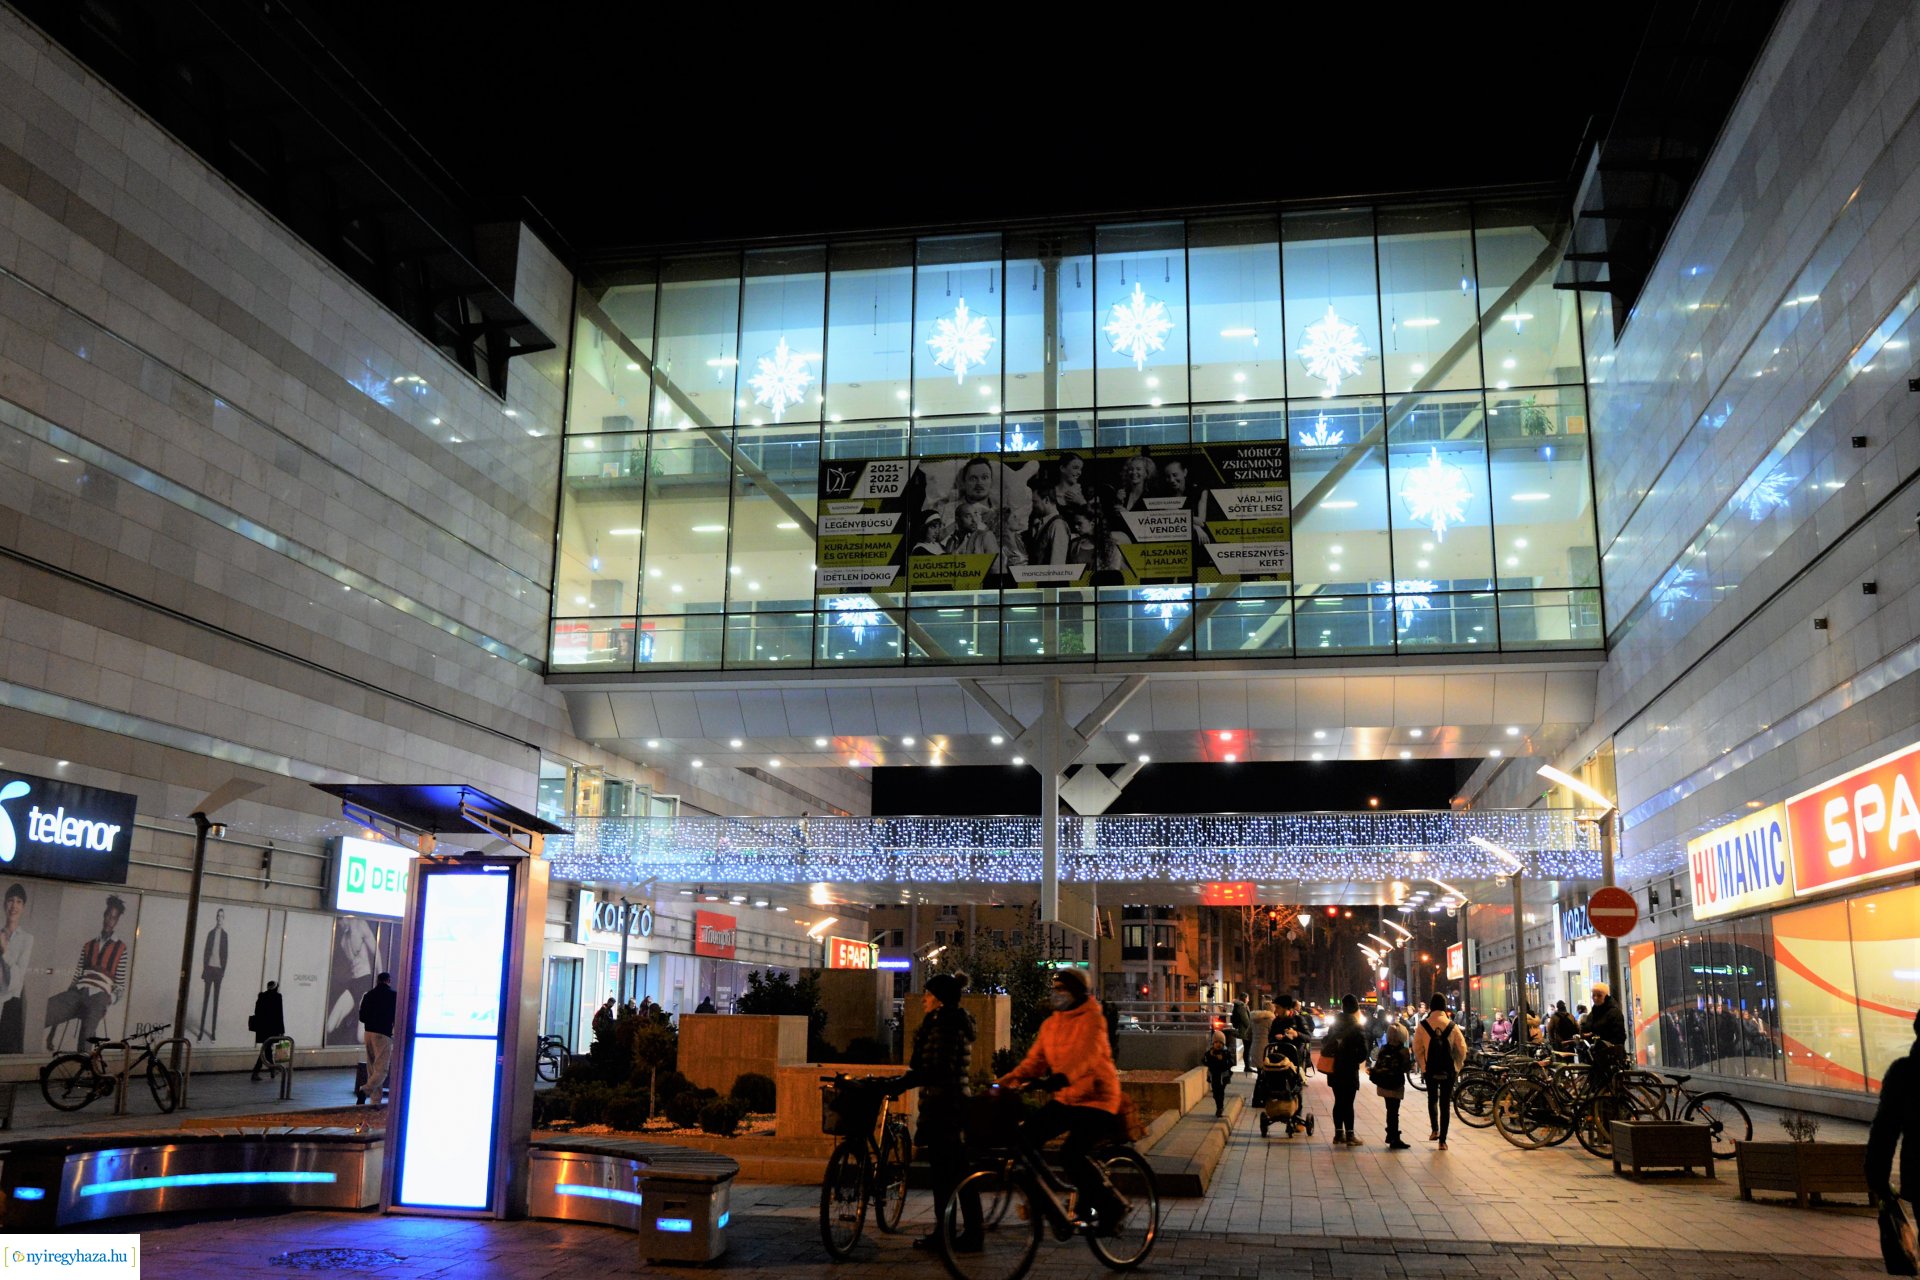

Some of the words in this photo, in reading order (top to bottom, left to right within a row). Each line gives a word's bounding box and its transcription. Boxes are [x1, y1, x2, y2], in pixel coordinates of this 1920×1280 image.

[1238, 447, 1282, 458] MÓRICZ
[870, 464, 904, 473] 2021-
[1222, 458, 1282, 469] ZSIGMOND
[870, 474, 899, 483] 2022
[1234, 468, 1282, 479] SZÍNHÁZ
[869, 483, 899, 494] ÉVAD
[1228, 504, 1258, 513] SÖTÉT
[1260, 504, 1283, 512] LESZ
[825, 517, 893, 530] LEGÉNYBÚCSÚ
[1138, 515, 1187, 526] VÁRATLAN
[1150, 525, 1187, 534] VENDÉG
[1215, 525, 1284, 536] KÖZELLENSÉG
[824, 541, 863, 551] KURÁZSI
[865, 541, 892, 550] MAMA
[824, 551, 835, 560] ÉS
[837, 551, 888, 560] GYERMEKEI
[1140, 548, 1188, 557] ALSZANAK
[1217, 548, 1289, 559] CSERESZNYÉS-
[913, 561, 966, 570] AUGUSZTUS
[1146, 558, 1154, 566] A
[1154, 557, 1188, 566] HALAK?
[1259, 559, 1284, 567] KERT
[823, 571, 859, 582] IDÉTLEN
[28, 805, 121, 852] telenor
[1692, 820, 1785, 907] HUMANIC
[839, 943, 868, 969] SPAR
